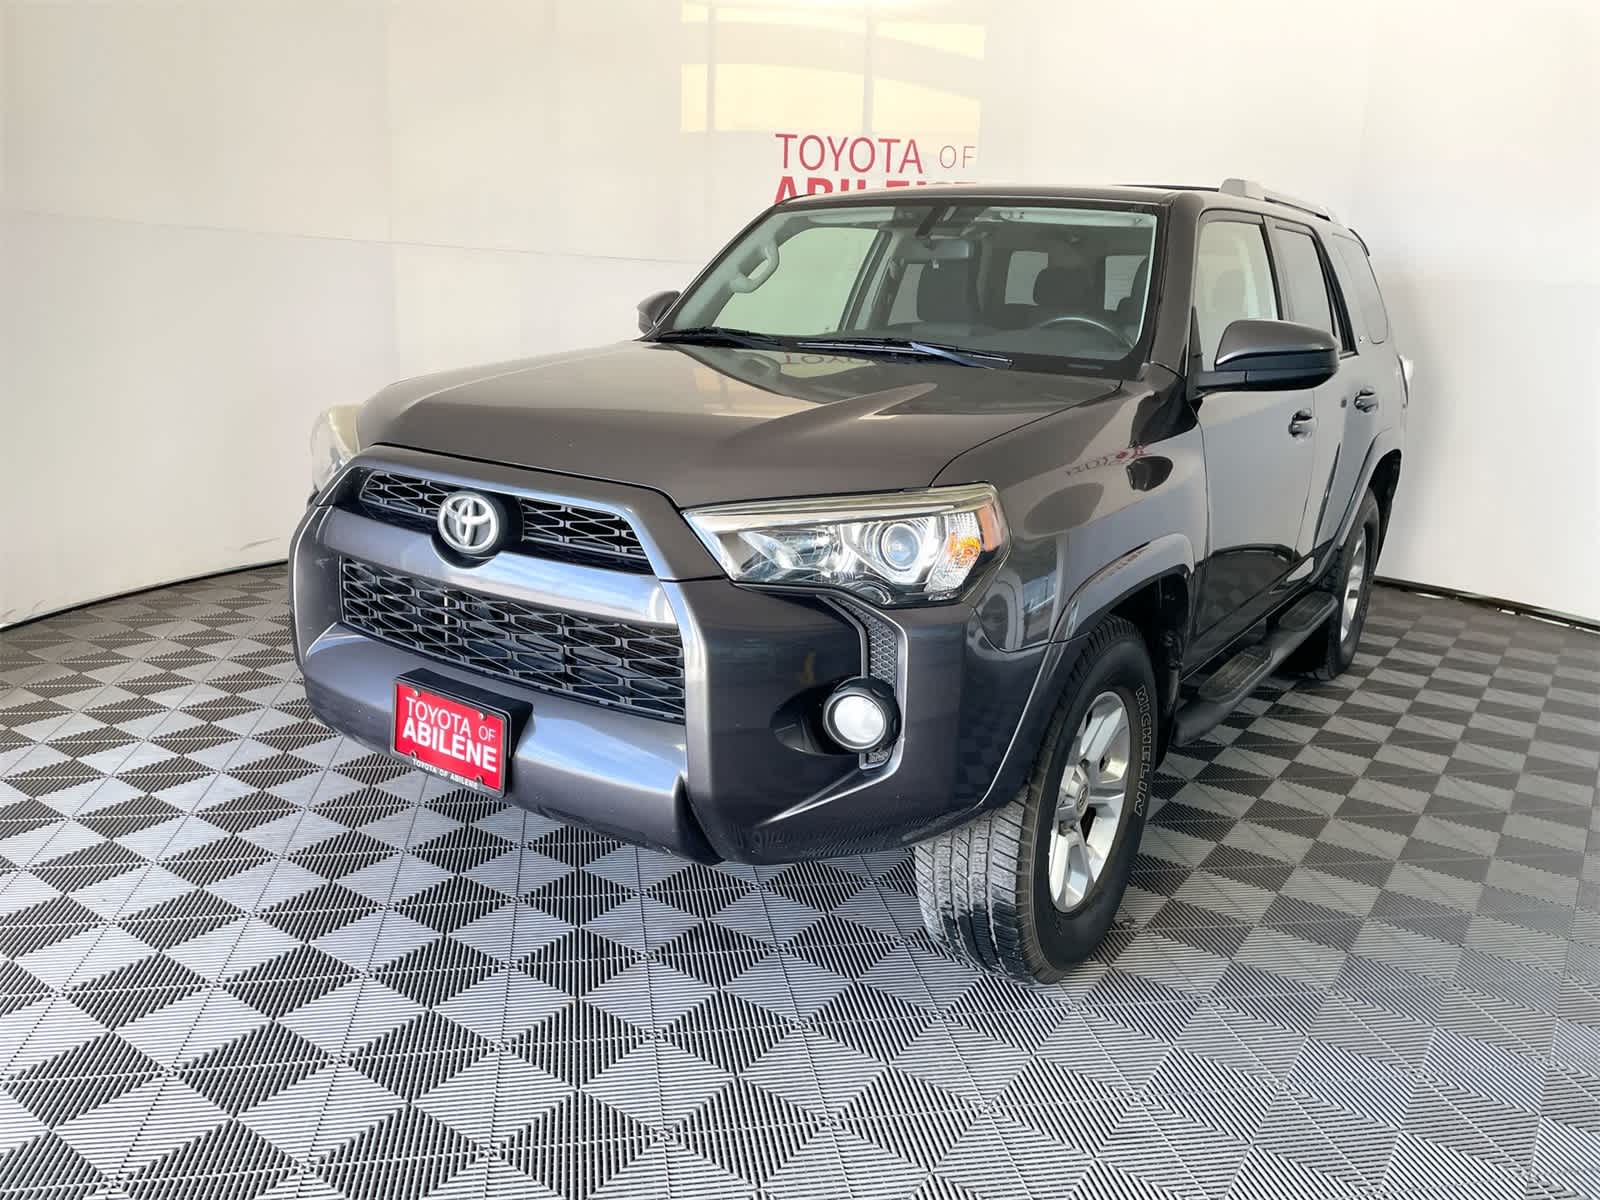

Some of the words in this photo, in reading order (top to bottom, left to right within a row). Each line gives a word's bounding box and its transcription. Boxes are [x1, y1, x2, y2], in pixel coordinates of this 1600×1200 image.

[775, 133, 923, 174] TOYOTA
[939, 145, 976, 169] OF
[405, 696, 472, 738] TOYOTA
[478, 725, 496, 742] OF
[402, 717, 497, 773] ABILENE
[412, 758, 437, 773] TOYOTA
[1135, 684, 1152, 816] MICHELIN
